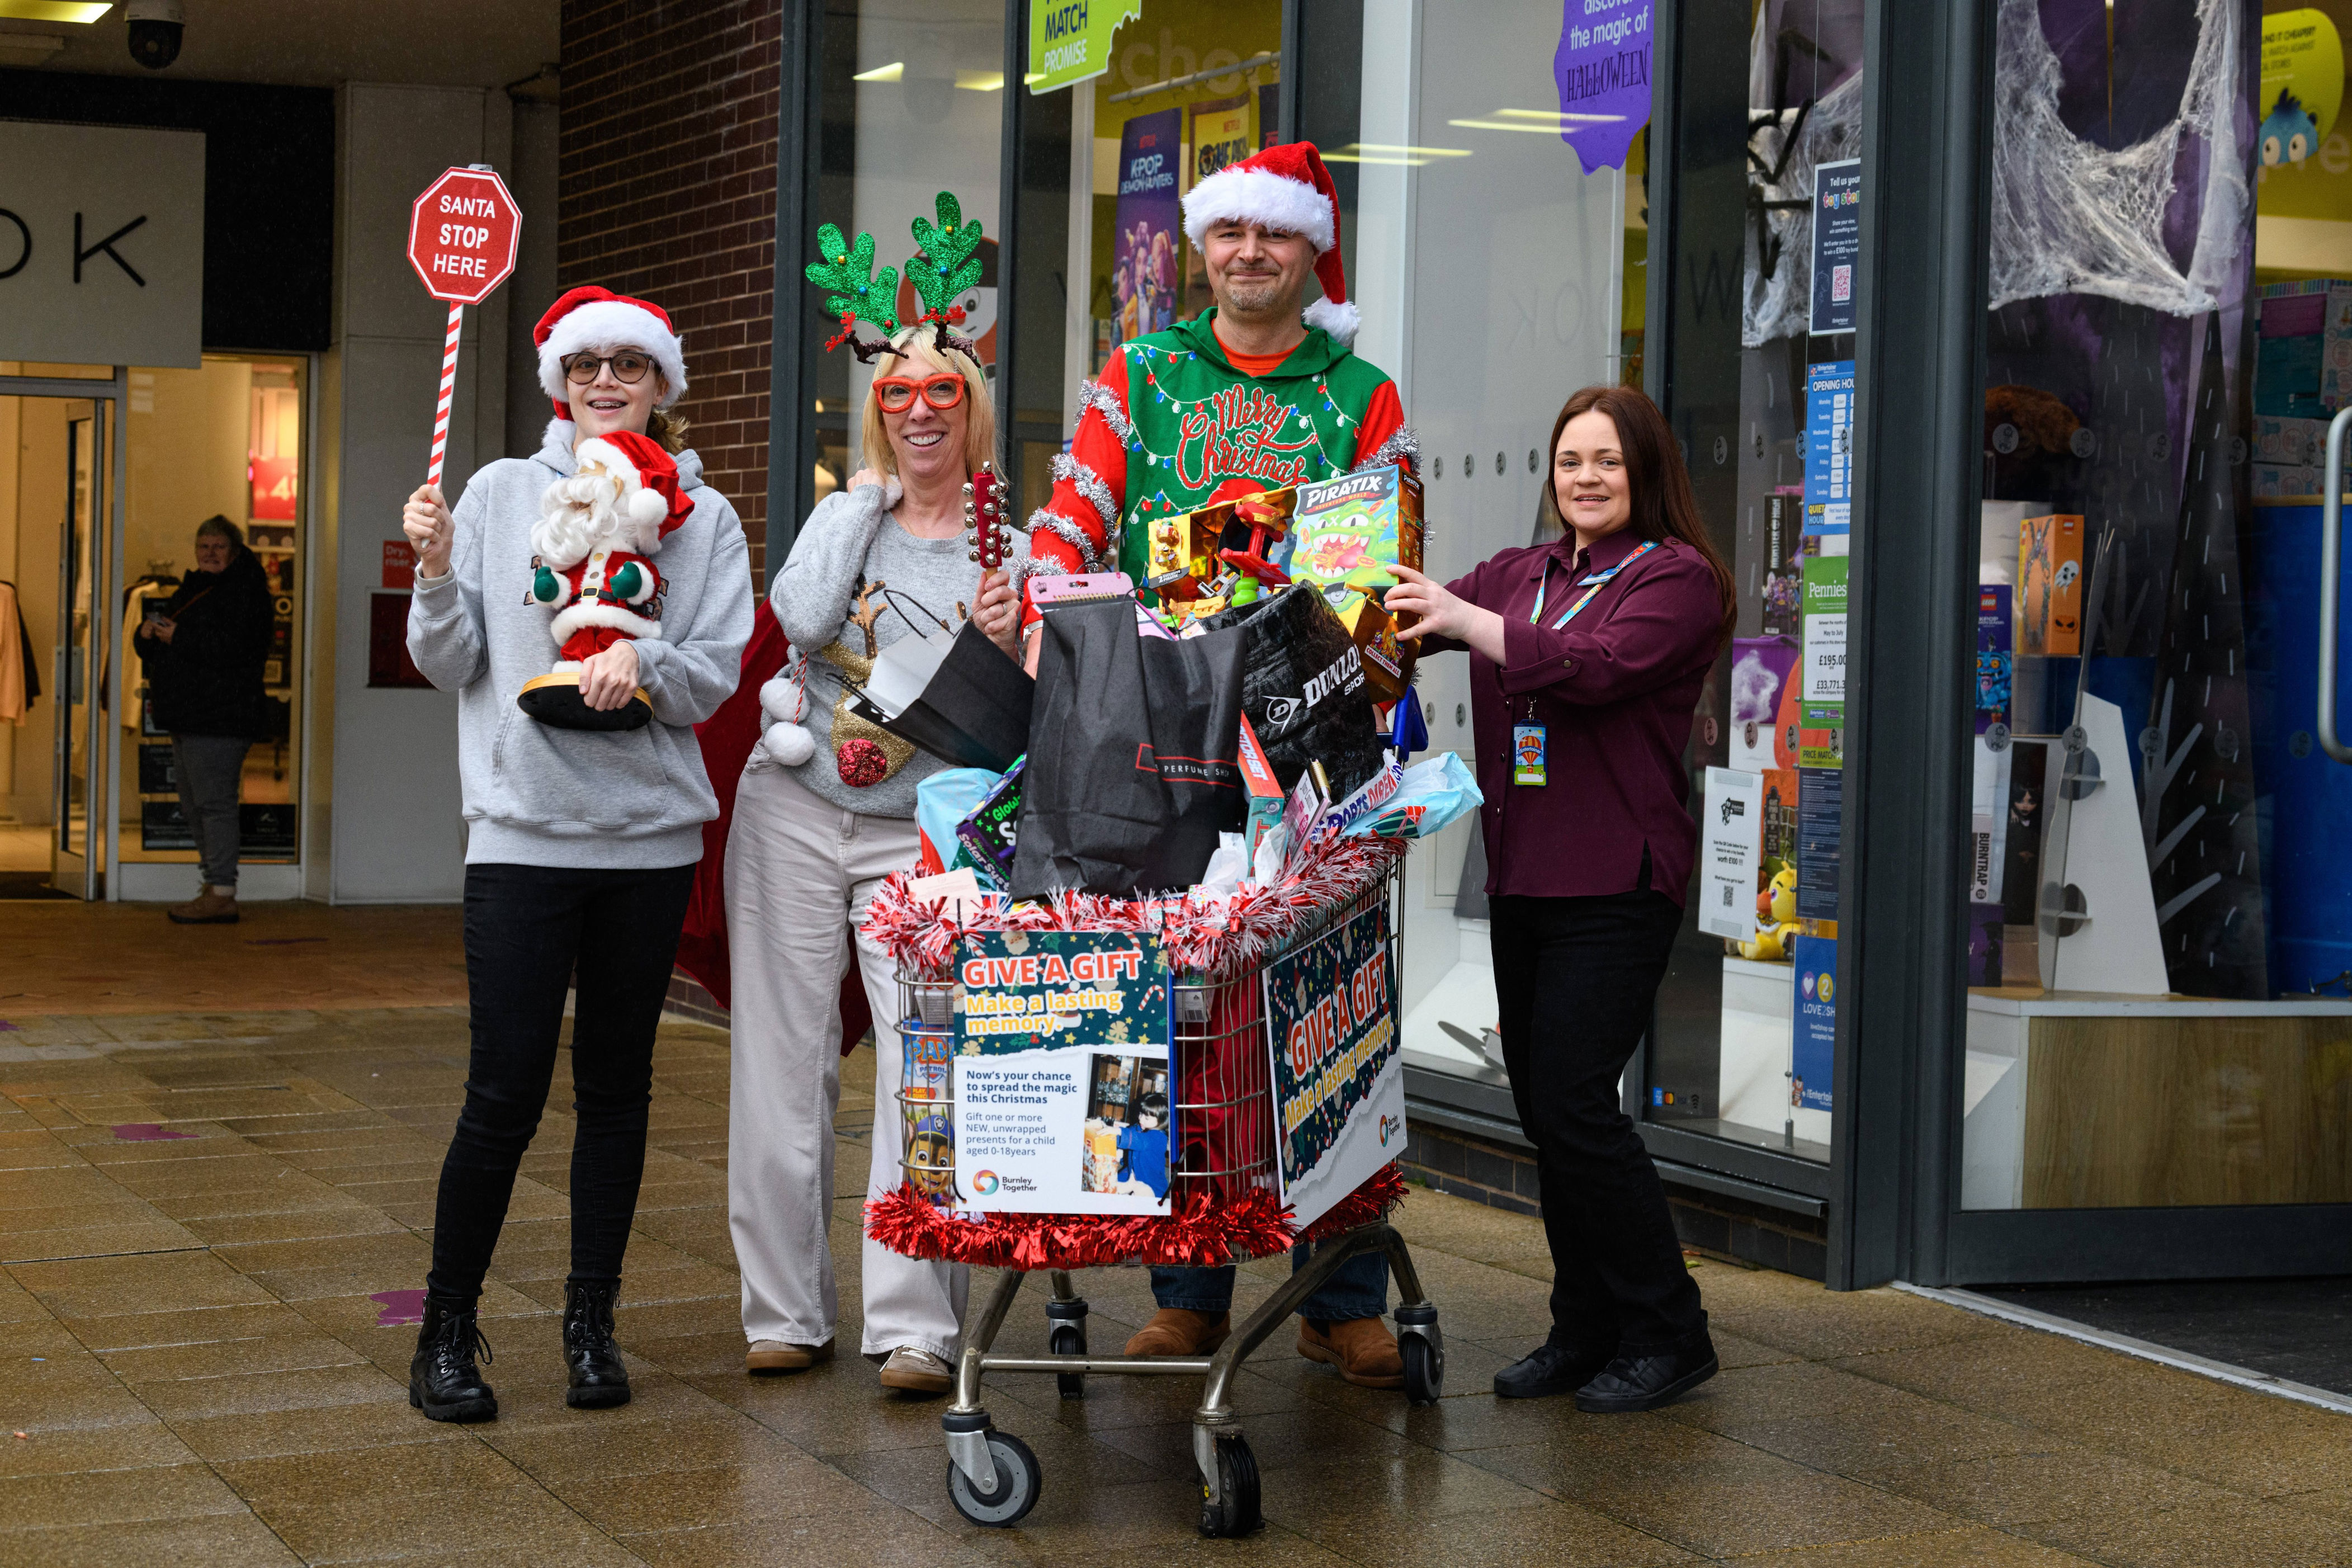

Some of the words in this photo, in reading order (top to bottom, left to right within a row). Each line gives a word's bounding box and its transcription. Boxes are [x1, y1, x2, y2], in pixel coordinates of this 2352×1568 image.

[1045, 0, 1088, 42] MATCH
[1570, 25, 1590, 51] the
[1594, 12, 1632, 46] magic
[1635, 5, 1649, 33] of
[1045, 39, 1087, 74] PROMISE
[1567, 41, 1651, 102] HALLOWEEN
[1830, 177, 1840, 186] Tell
[440, 195, 496, 219] SANTA
[1824, 191, 1840, 209] toy
[439, 223, 489, 249] STOP
[433, 253, 488, 278] HERE
[1813, 379, 1840, 391] OPENING
[1212, 383, 1314, 452] Merry
[1175, 413, 1311, 490] Christmas
[1306, 475, 1382, 508] PIRATIX
[1404, 475, 1420, 490] PIRATIX
[1315, 496, 1346, 511] ADVENTURE
[1348, 492, 1367, 500] WORLD
[1808, 504, 1825, 515] QUIET
[1808, 514, 1825, 525] HOUR
[1808, 579, 1847, 598] Pennies
[1366, 647, 1382, 662] COLLECT
[1382, 660, 1393, 670] THEM
[1819, 655, 1846, 666] £195.00
[1272, 703, 1290, 719] D
[1803, 750, 1816, 758] PRICE
[1164, 765, 1208, 776] PERFUME
[1215, 768, 1229, 778] SHOP
[992, 795, 1021, 822] Glow-
[958, 833, 988, 865] Solar
[972, 837, 1010, 881] Glow-in-the
[1977, 832, 1990, 886] BURNTRAP
[964, 957, 1037, 985] GIVE
[1044, 956, 1069, 982] A
[1072, 952, 1141, 980] GIFT
[1822, 979, 1829, 996] 2
[966, 994, 1024, 1013] Make
[1029, 996, 1042, 1011] a
[1048, 990, 1121, 1012] lasting
[1803, 1003, 1835, 1017] LOVE2SH
[1292, 999, 1334, 1077] GIVE
[1338, 986, 1351, 1040] A
[1352, 952, 1387, 1024] GIFT
[967, 1016, 1061, 1035] memory.
[906, 1040, 954, 1064] PAW
[920, 1065, 946, 1078] PATROL
[966, 1070, 1000, 1080] Now’s
[1004, 1072, 1029, 1082] your
[1032, 1071, 1071, 1081] chance
[1286, 1088, 1314, 1131] Make
[1316, 1081, 1323, 1104] a
[1323, 1052, 1356, 1097] lasting
[1356, 1014, 1394, 1065] memory.
[981, 1083, 1019, 1093] spread
[1022, 1083, 1041, 1092] the
[1044, 1083, 1078, 1094] magic
[966, 1094, 988, 1103] this
[991, 1094, 1048, 1104] Christmas
[966, 1112, 983, 1121] Gift
[1388, 1114, 1398, 1128] Burnley
[966, 1123, 990, 1133] NEW,
[993, 1125, 1046, 1135] unwrapped
[1388, 1122, 1401, 1137] Together
[966, 1136, 1007, 1145] presents
[1009, 1136, 1022, 1144] for
[1033, 1136, 1055, 1145] child
[966, 1146, 989, 1157] aged
[991, 1147, 1036, 1158] 0-18years
[1002, 1184, 1038, 1192] Together
